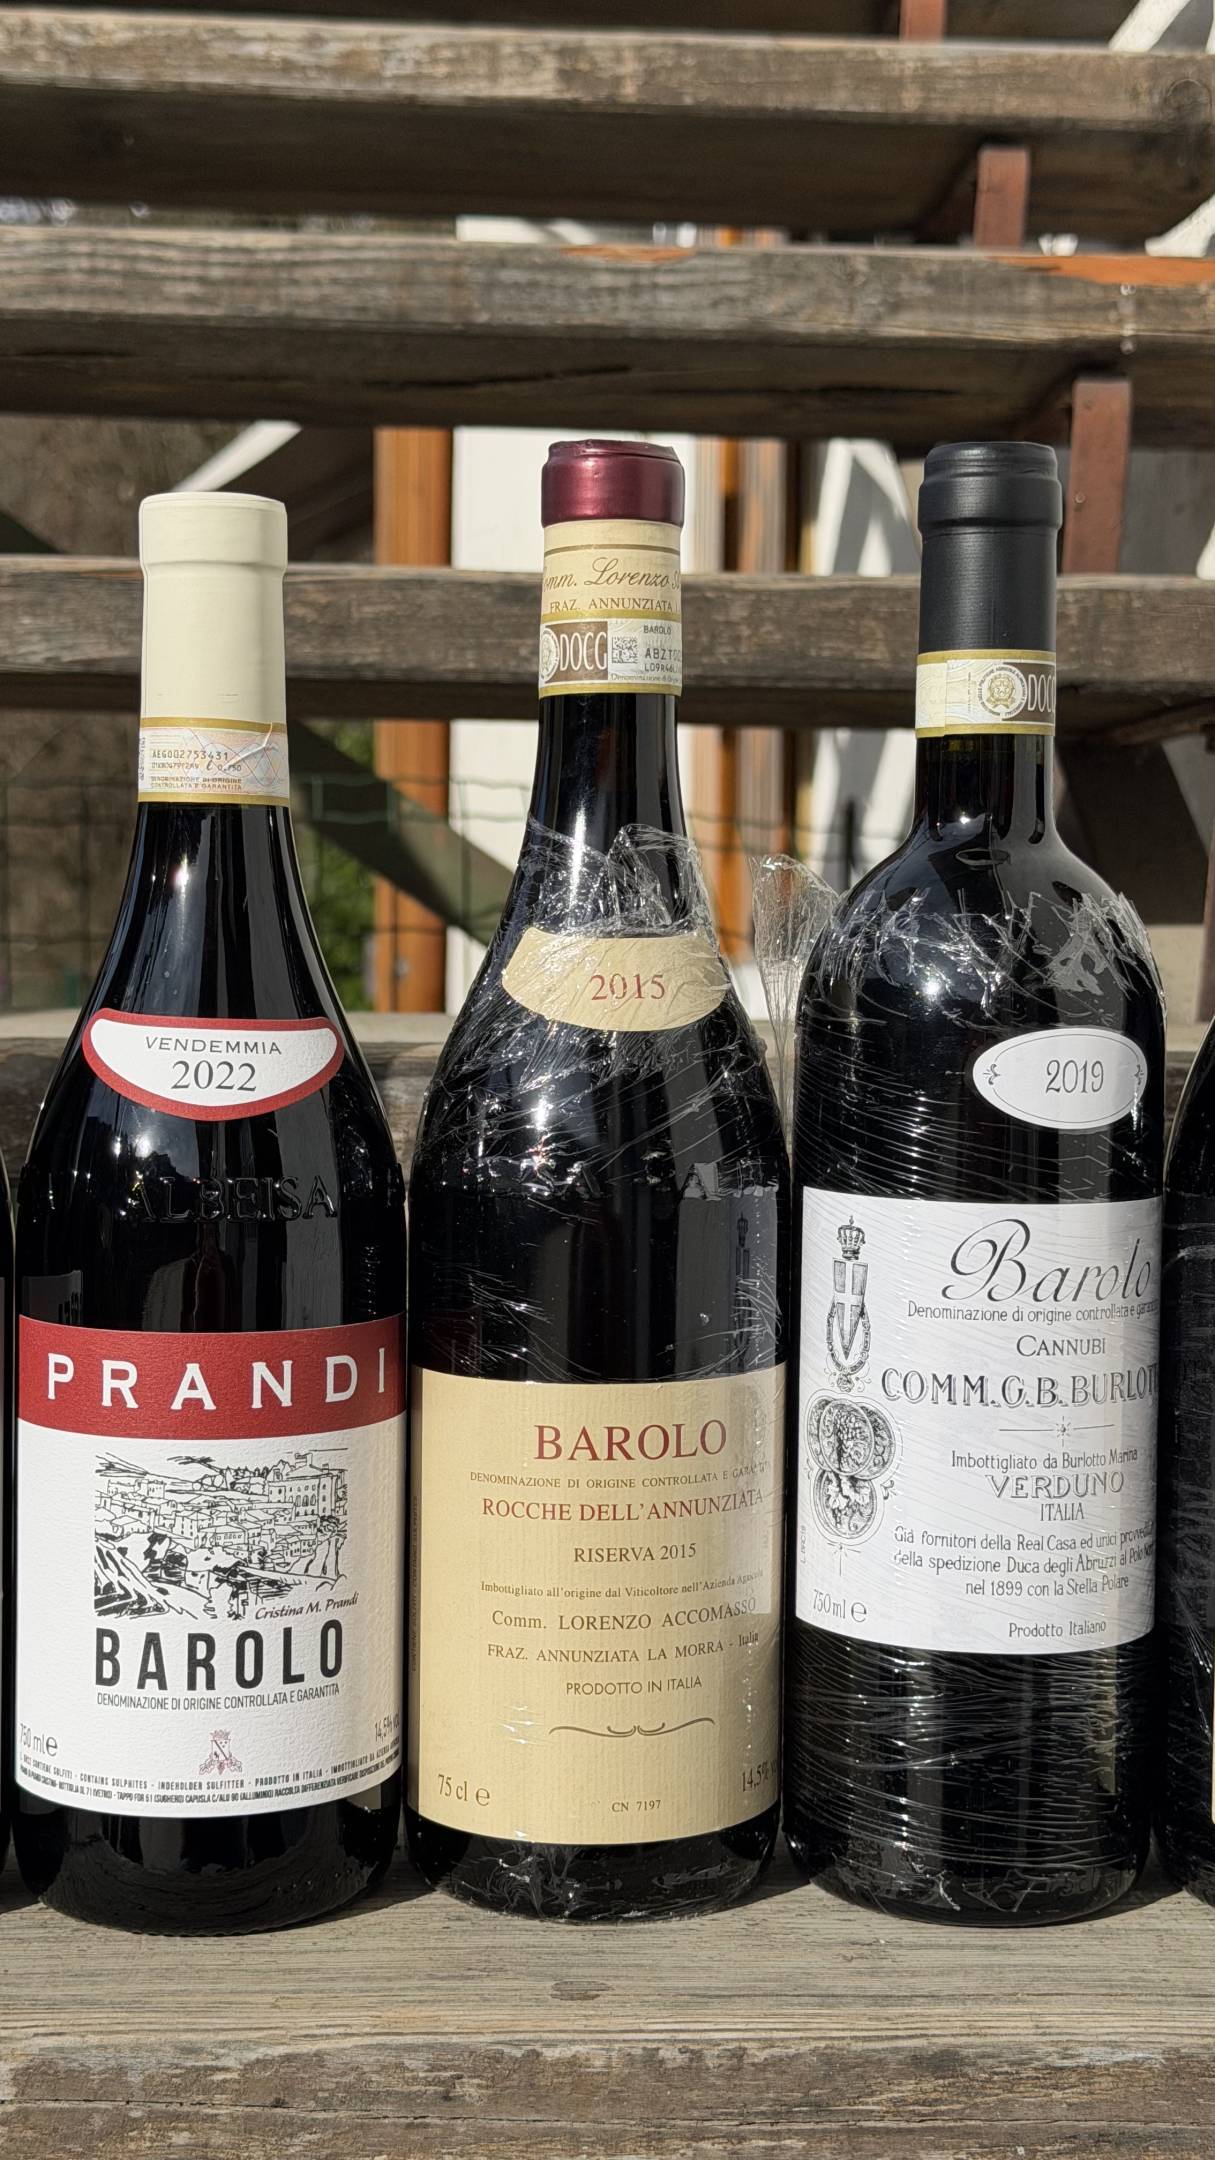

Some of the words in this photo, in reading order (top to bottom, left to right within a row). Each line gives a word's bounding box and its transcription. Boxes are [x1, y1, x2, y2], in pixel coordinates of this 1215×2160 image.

[584, 556, 670, 587] Lorenzo
[550, 598, 580, 614] FRAZ.
[589, 597, 672, 612] ANNUNZIATA
[643, 625, 672, 635] BAROLO
[560, 631, 607, 672] DOCG
[591, 973, 666, 1001] 2015
[145, 1036, 283, 1055] VENDEMMIA
[170, 1059, 257, 1092] 2022
[1045, 1059, 1104, 1094] 2019
[941, 1218, 1151, 1303] Barolo
[908, 1300, 1008, 1322] Denominazione
[1012, 1306, 1024, 1322] di
[1028, 1307, 1072, 1326] origine
[1076, 1301, 1129, 1321] controllata
[1016, 1334, 1106, 1357] CANNUBI
[47, 1347, 385, 1410] PRANDI
[534, 1419, 727, 1462] BAROLO
[951, 1450, 1037, 1473] Imbottigliato
[1043, 1454, 1058, 1470] da
[1062, 1453, 1106, 1468] Burlotto
[1109, 1447, 1138, 1465] Marina
[470, 1470, 561, 1488] DENOMINAZIONE
[567, 1477, 580, 1489] DI
[586, 1477, 636, 1489] ORIGINE
[642, 1472, 719, 1488] CONTROLLATA
[723, 1471, 728, 1480] E
[985, 1471, 1125, 1500] VERDUNO
[482, 1497, 572, 1521] ROCCHE
[579, 1488, 764, 1521] DELL'ANNUNZIATA
[1040, 1502, 1085, 1522] ITALIA
[574, 1546, 655, 1563] RISERVA
[660, 1543, 697, 1560] 2015
[921, 1530, 976, 1549] fornitori
[980, 1533, 1011, 1551] della
[1017, 1534, 1044, 1551] Real
[1047, 1535, 1076, 1551] Casa
[1080, 1533, 1093, 1549] ed
[928, 1555, 1001, 1576] spedizione
[1007, 1557, 1040, 1574] Duca
[1043, 1558, 1073, 1577] degli
[1075, 1553, 1117, 1572] Abruzzi
[481, 1581, 544, 1597] Imbottigliato
[546, 1586, 602, 1600] all'origine
[605, 1587, 621, 1598] dal
[625, 1584, 679, 1598] Viticoltore
[965, 1579, 985, 1596] nel
[991, 1579, 1023, 1596] 1899
[1027, 1581, 1050, 1596] con
[1053, 1580, 1064, 1596] la
[1066, 1578, 1098, 1595] Stella
[1102, 1573, 1129, 1592] Polare
[255, 1603, 303, 1620] Cristina
[305, 1599, 323, 1615] M.
[325, 1592, 360, 1614] Prandi
[491, 1610, 547, 1630] Comm.
[558, 1613, 651, 1631] LORENZO
[662, 1596, 757, 1627] ACCOMASSO
[813, 1588, 829, 1613] 750
[832, 1598, 847, 1619] ml
[1008, 1620, 1063, 1638] Prodotto
[1069, 1619, 1107, 1636] Italiano
[94, 1618, 343, 1691] BAROLO
[487, 1643, 529, 1661] FRAZ.
[536, 1649, 639, 1663] ANNUNZIATA
[647, 1648, 667, 1661] LA
[674, 1640, 724, 1659] MORRA
[97, 1692, 170, 1711] DENOMINAZIONE
[171, 1697, 182, 1711] DI
[183, 1696, 222, 1711] ORIGINE
[223, 1691, 289, 1710] CONTROLLATA
[289, 1690, 296, 1704] E
[297, 1682, 340, 1703] GARANTITA
[566, 1680, 643, 1696] PRODOTTO
[647, 1679, 662, 1693] IN
[666, 1675, 703, 1691] ITALIA
[80, 1773, 109, 1786] CONTAINS
[111, 1777, 148, 1790] SULPHITES
[158, 1781, 203, 1791] INDEHOLDER
[206, 1779, 245, 1791] SULFITTER
[255, 1774, 290, 1787] PRODOTTO
[293, 1772, 299, 1782] IN
[303, 1768, 323, 1780] ITALIA
[437, 1773, 452, 1798] 75
[455, 1780, 468, 1803] cl
[612, 1802, 630, 1813] CN
[636, 1800, 662, 1812] 7197
